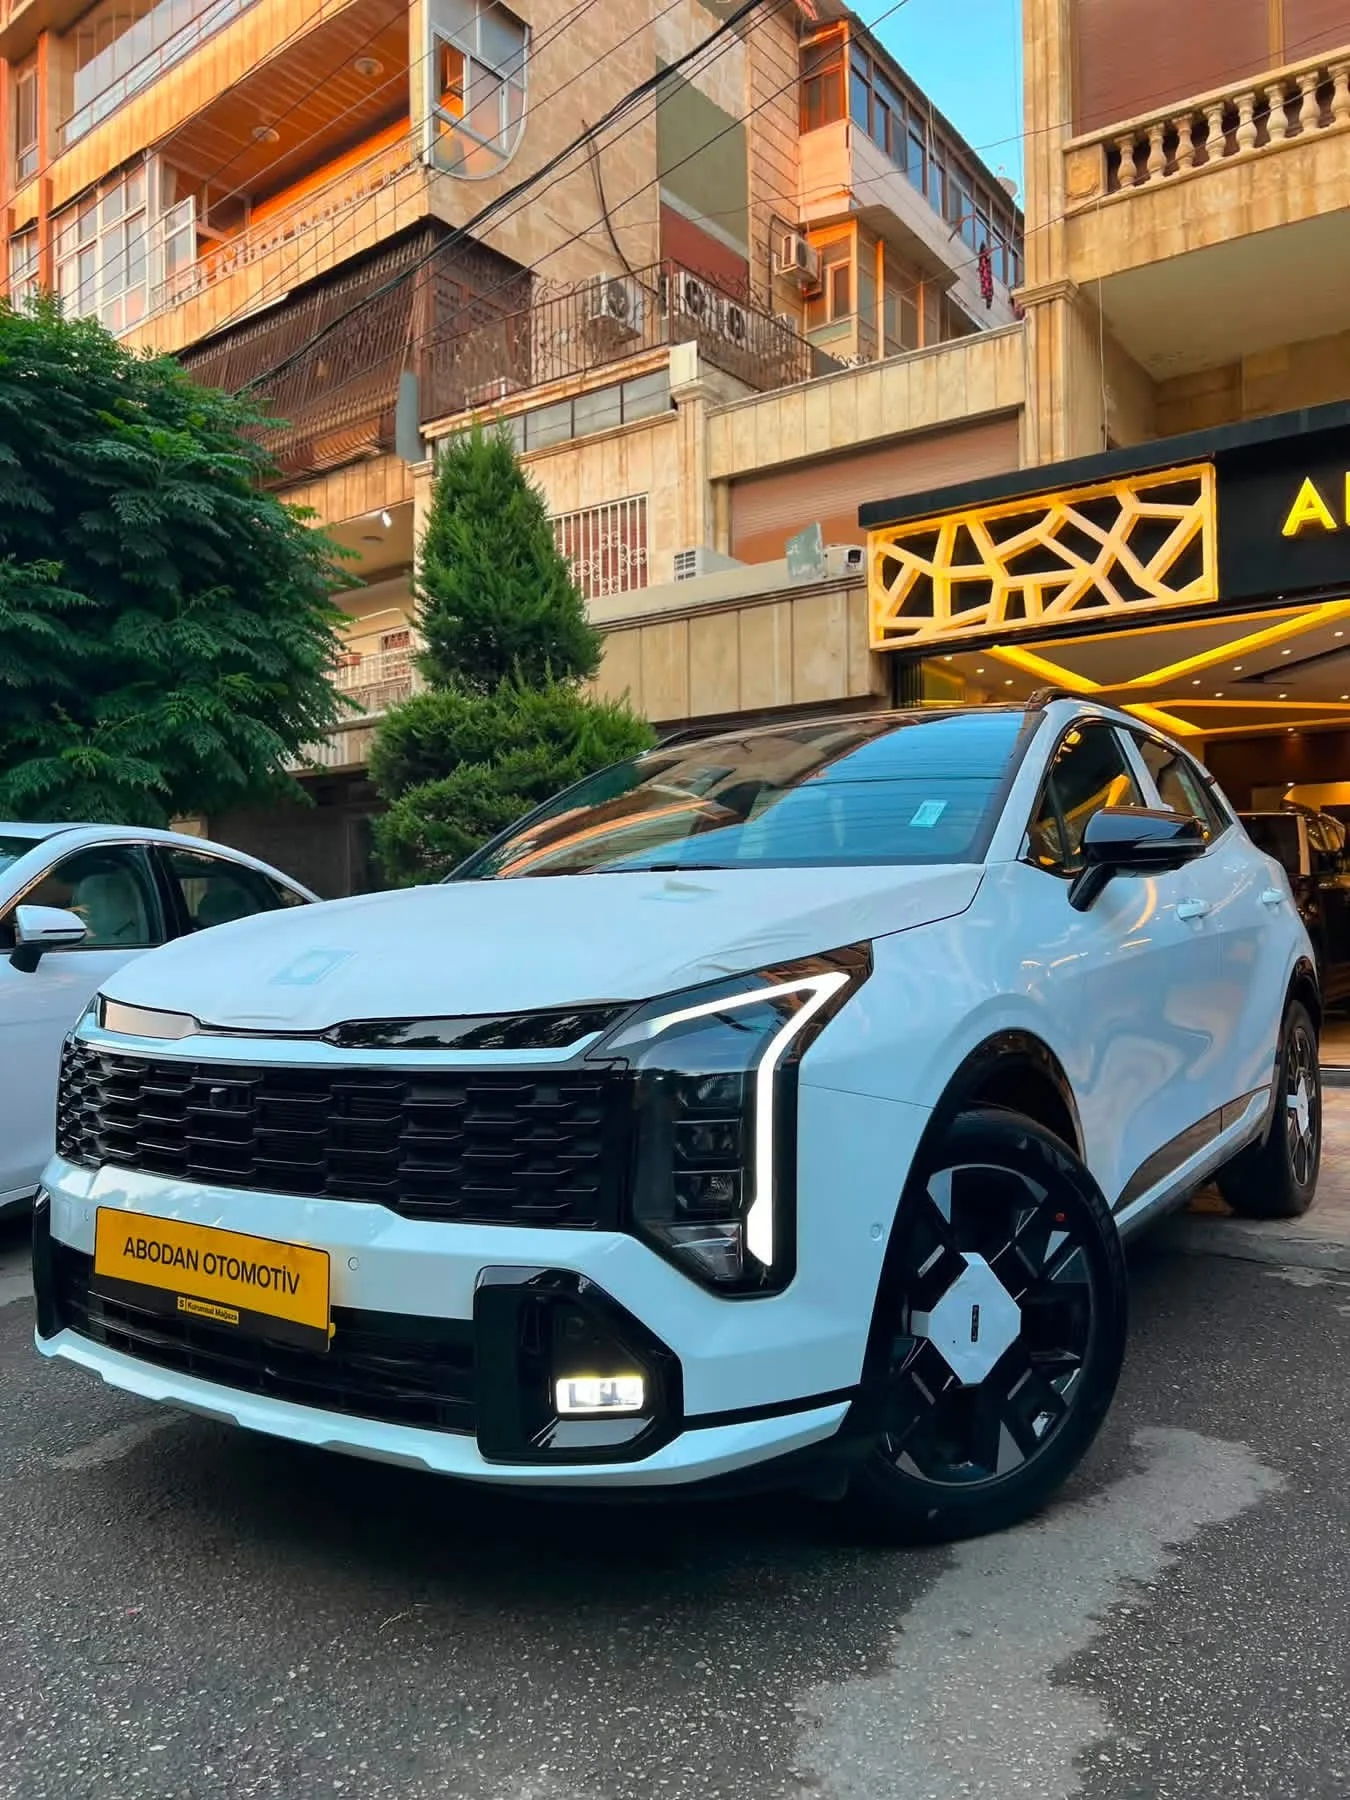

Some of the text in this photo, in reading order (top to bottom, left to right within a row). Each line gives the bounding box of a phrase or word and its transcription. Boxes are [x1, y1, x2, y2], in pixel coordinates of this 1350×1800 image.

[1282, 471, 1350, 536] A
[123, 1236, 300, 1295] ABODAN OTOMOTİV
